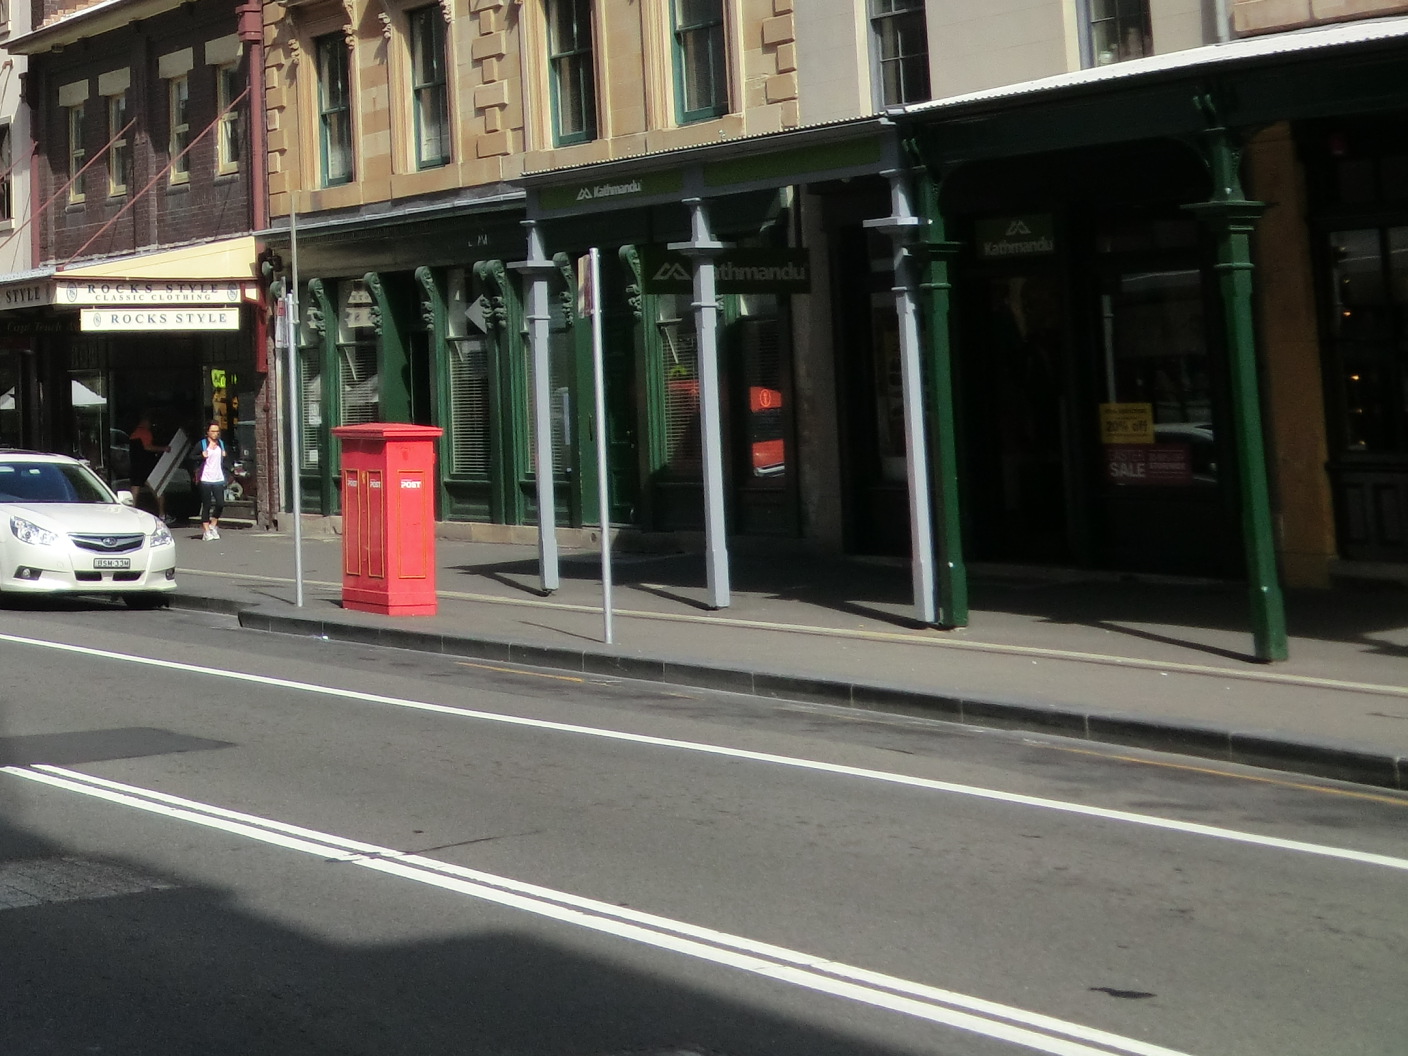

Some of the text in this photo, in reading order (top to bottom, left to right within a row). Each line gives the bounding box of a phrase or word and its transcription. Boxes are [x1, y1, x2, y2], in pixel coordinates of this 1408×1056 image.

[593, 180, 642, 198] Kathmandu
[983, 236, 1055, 257] Kathmandu
[713, 261, 806, 281] athmandu
[6, 286, 41, 305] STYLE
[87, 283, 218, 294] ROCKS STYLE
[110, 313, 227, 324] ROCKS STYLE
[1109, 462, 1147, 477] SALE
[400, 481, 422, 489] POST
